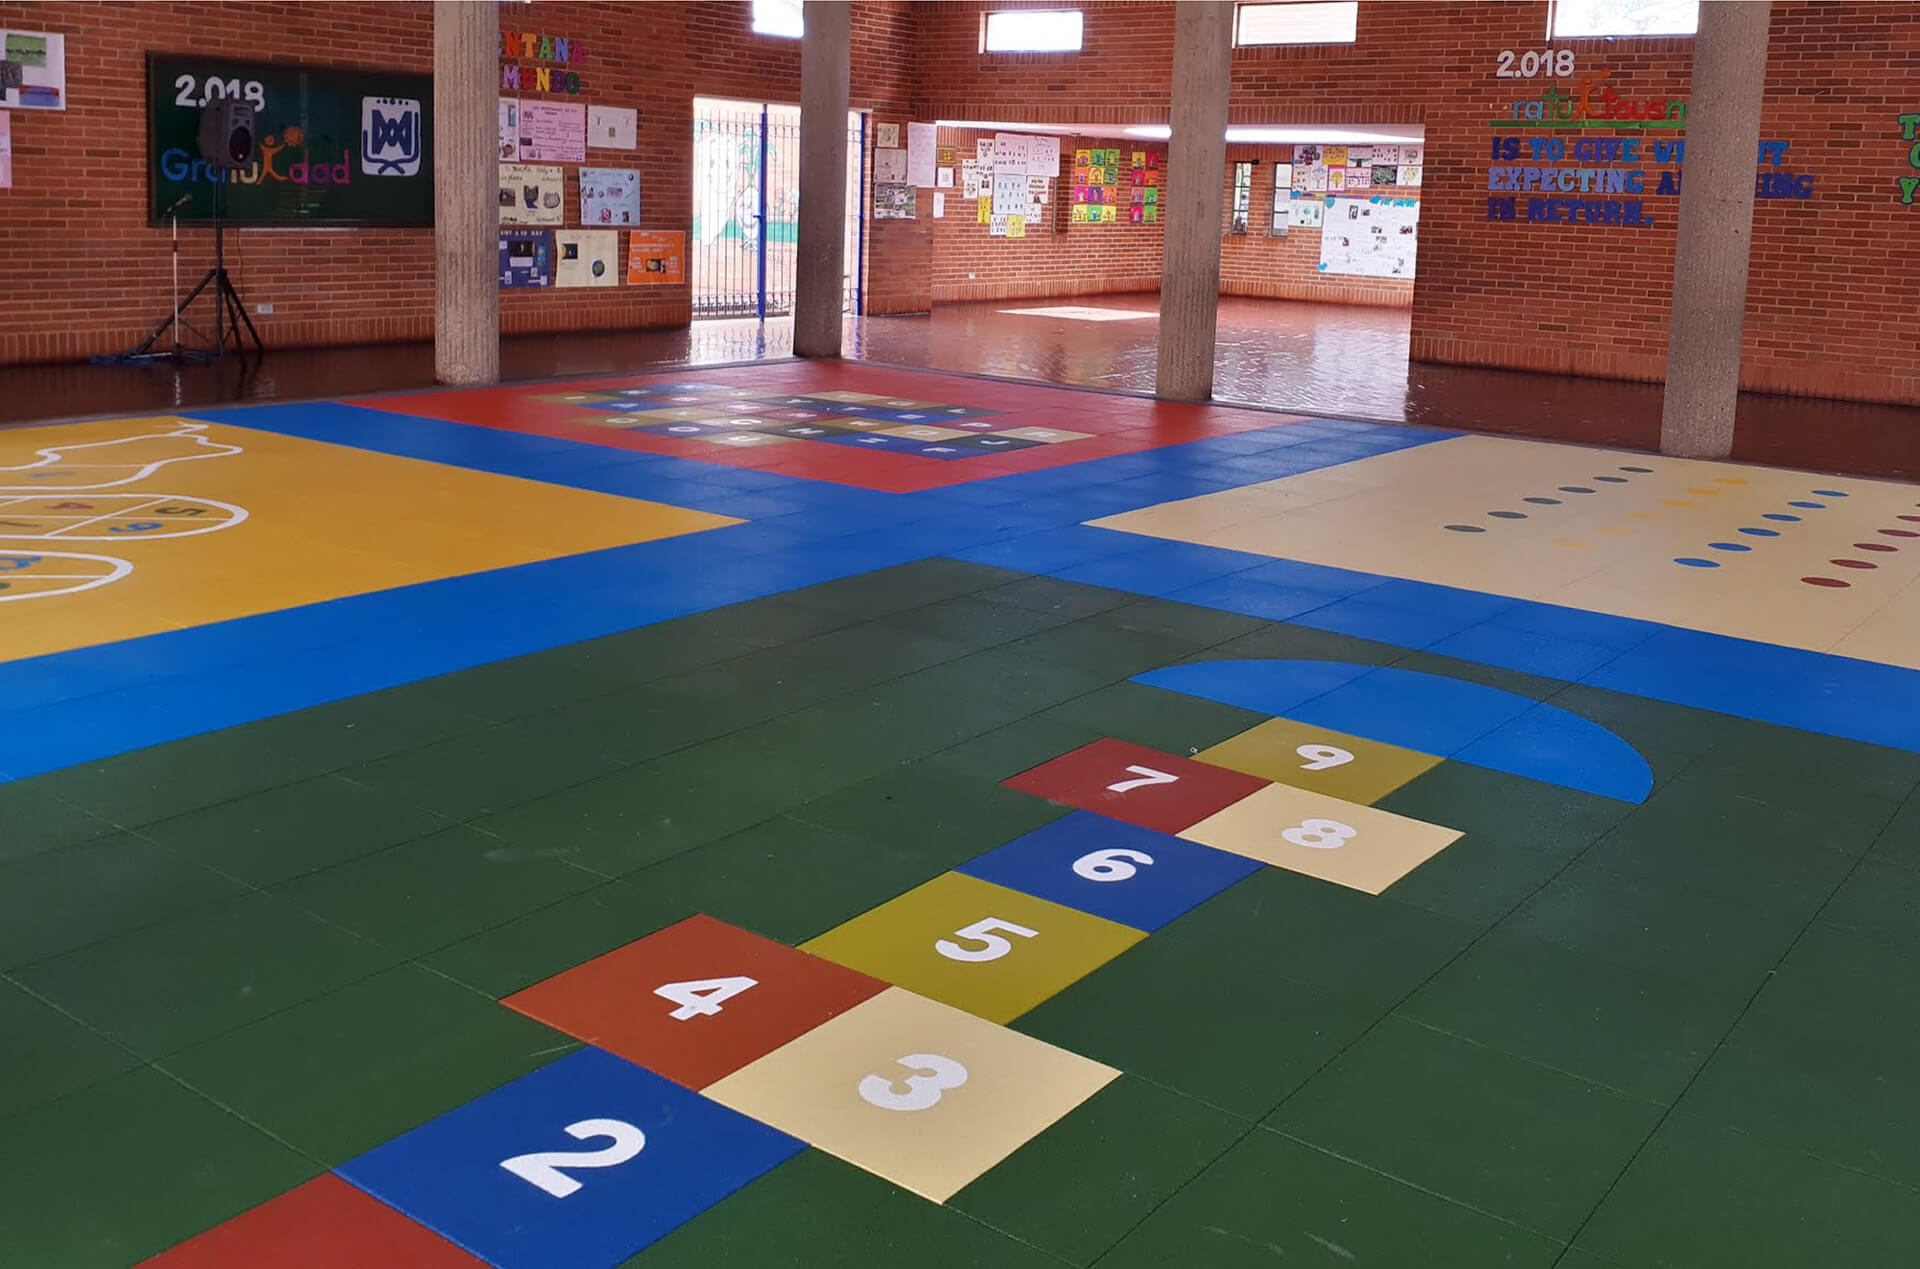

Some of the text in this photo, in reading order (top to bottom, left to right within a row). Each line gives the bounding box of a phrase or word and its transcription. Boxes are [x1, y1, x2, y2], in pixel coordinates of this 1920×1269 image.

[498, 32, 585, 64] NTANA
[1496, 49, 1575, 78] 2.018
[503, 64, 580, 94] MUNDO
[1492, 137, 1521, 161] IS
[1528, 138, 1563, 161] TO
[1574, 138, 1639, 163] GIVE
[1488, 166, 1645, 194] EXPECTING
[1488, 197, 1655, 226] IN RETURN.
[1296, 744, 1354, 770] 9
[1107, 765, 1179, 793] 7
[1281, 818, 1358, 850] 8
[1072, 849, 1154, 882] 6
[935, 917, 1039, 962] 5
[653, 976, 758, 1021] 4
[858, 1053, 969, 1111] 3
[500, 1119, 645, 1198] 2
